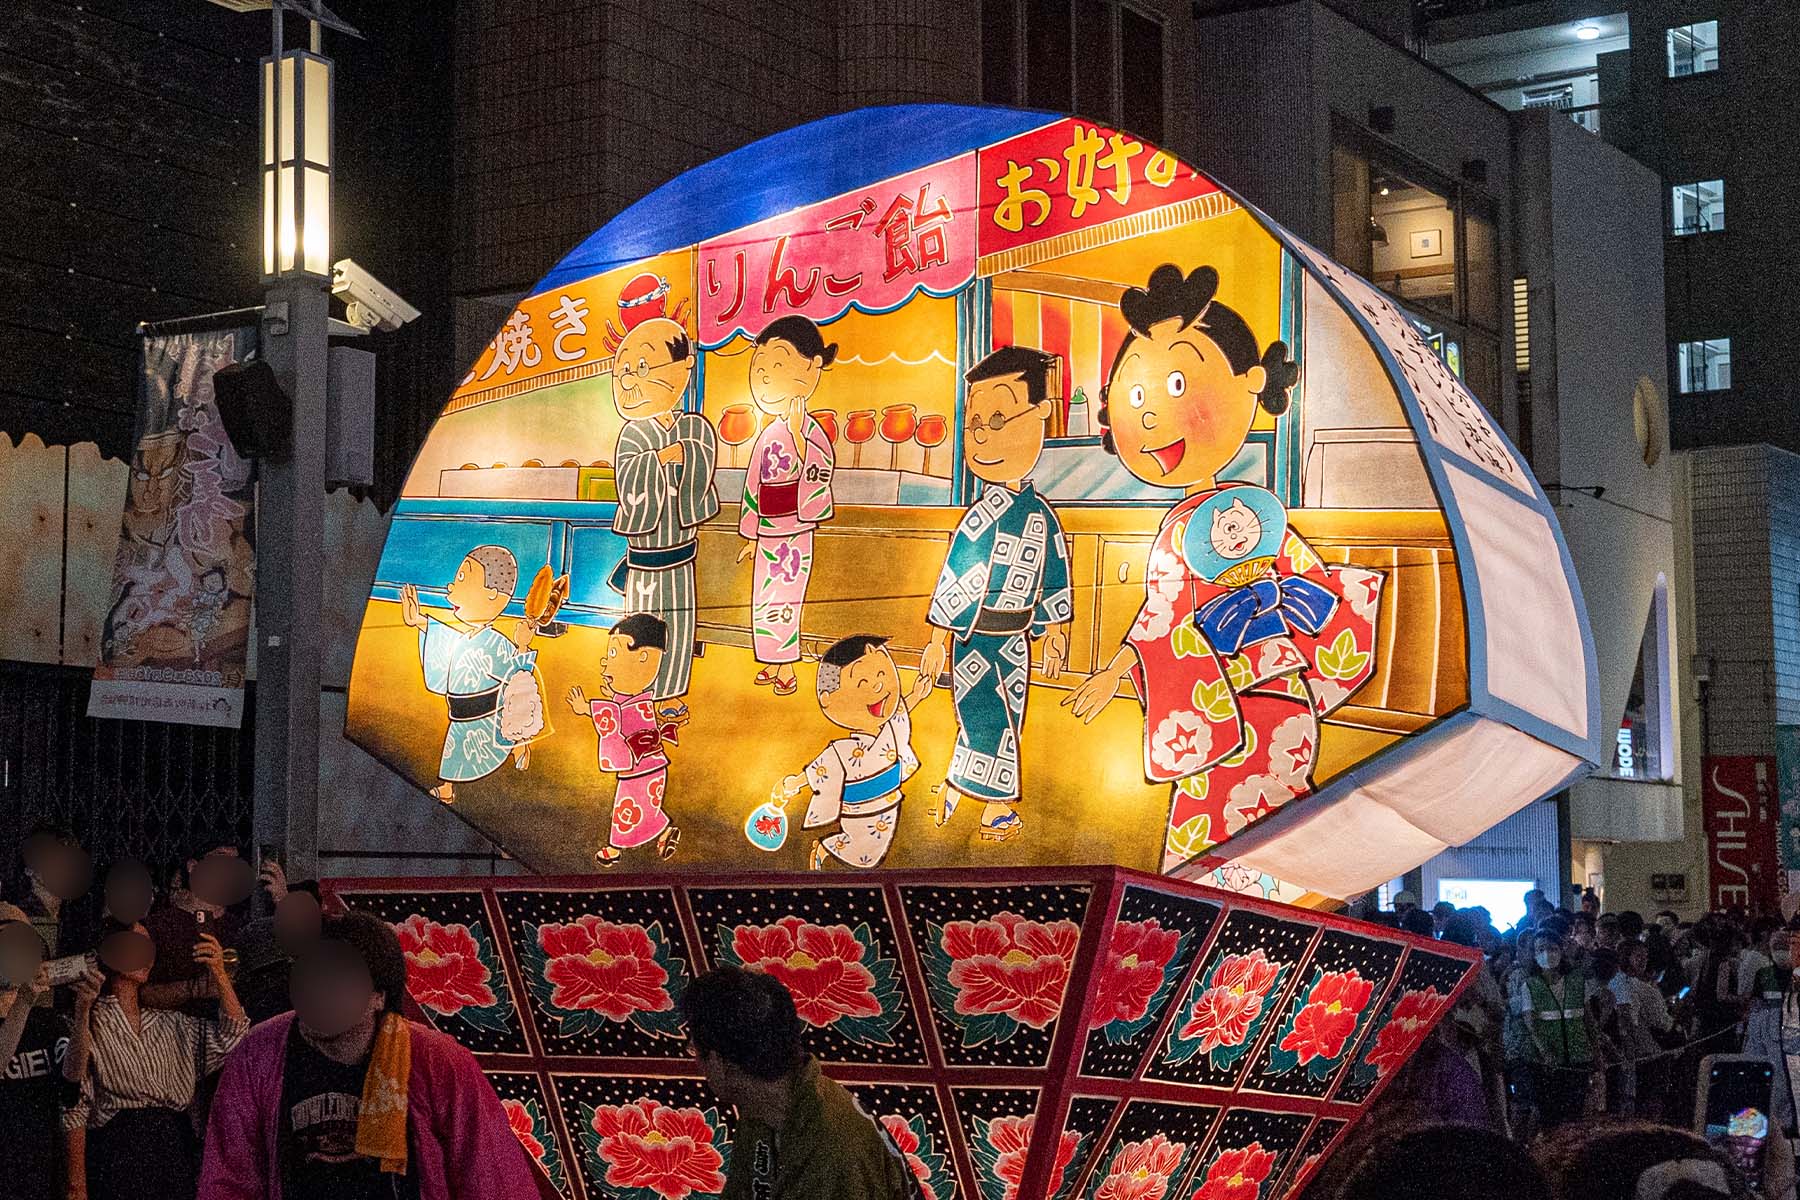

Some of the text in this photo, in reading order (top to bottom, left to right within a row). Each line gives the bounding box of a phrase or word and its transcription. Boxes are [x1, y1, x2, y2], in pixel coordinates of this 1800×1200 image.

[704, 182, 955, 326] りんご飴
[461, 294, 591, 387] 焼き
[1713, 765, 1751, 914] SHISE
